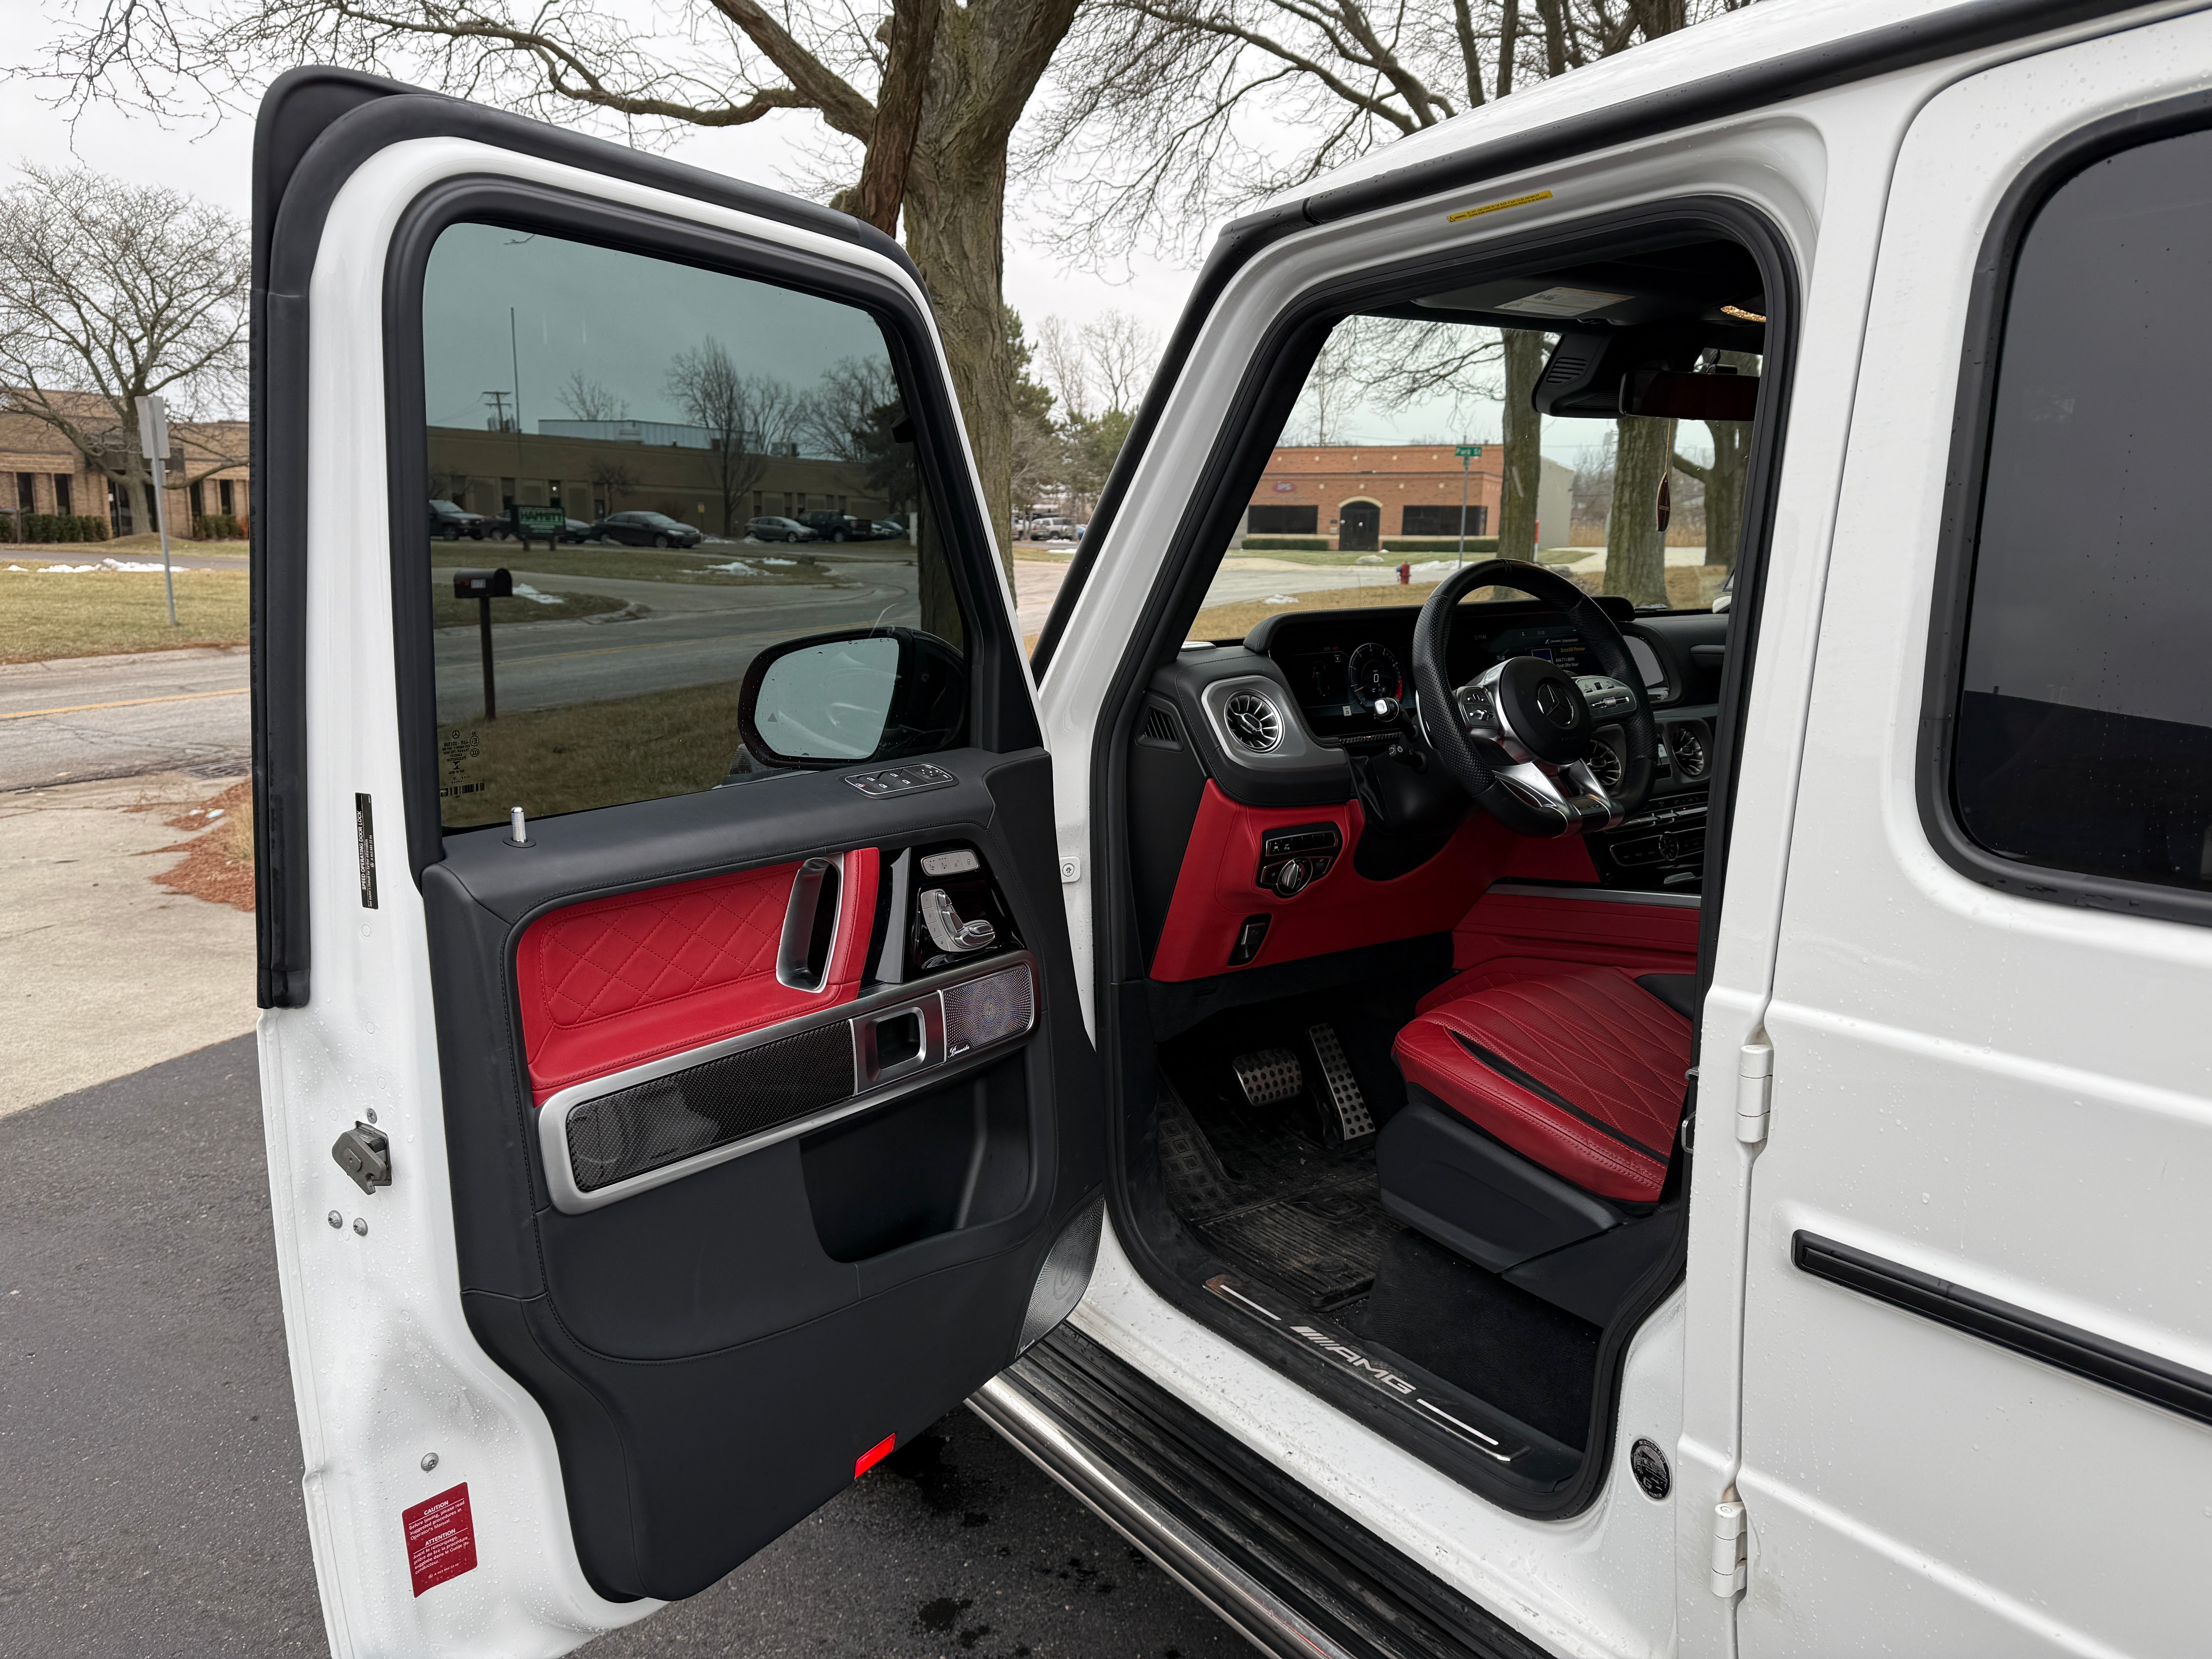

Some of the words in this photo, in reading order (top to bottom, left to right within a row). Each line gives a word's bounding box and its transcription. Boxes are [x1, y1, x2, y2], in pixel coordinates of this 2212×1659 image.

[424, 1500, 449, 1515] CAUTION
[409, 1521, 423, 1530] Before
[441, 1506, 454, 1516] please
[410, 1522, 432, 1535] suggested
[433, 1511, 457, 1525] procedures
[410, 1528, 433, 1540] Operator's
[425, 1528, 456, 1546] ATTENTION
[413, 1551, 425, 1559] Avant
